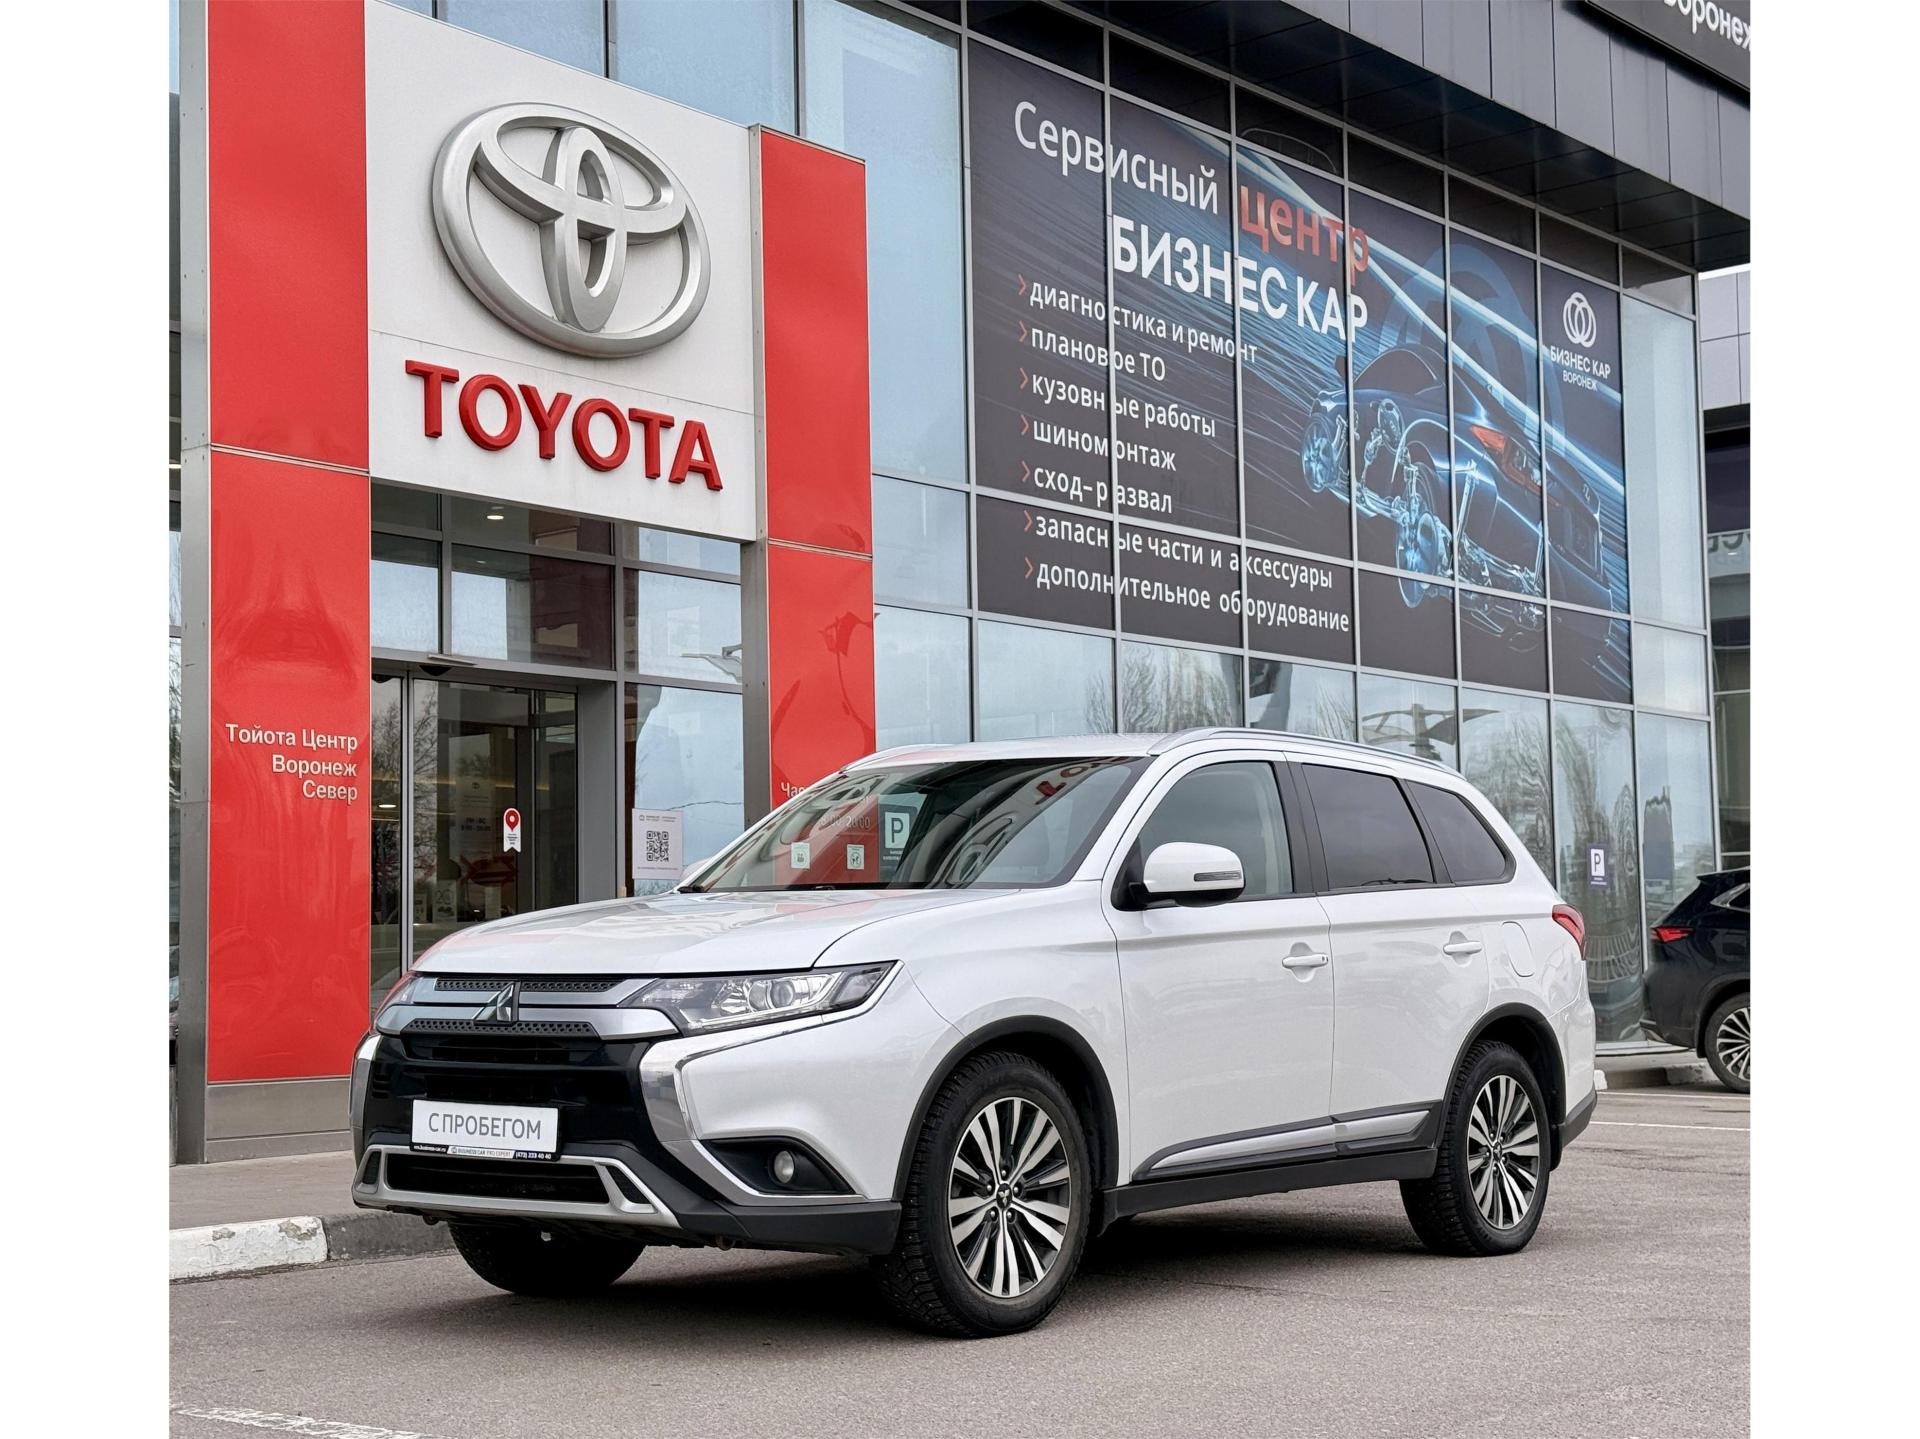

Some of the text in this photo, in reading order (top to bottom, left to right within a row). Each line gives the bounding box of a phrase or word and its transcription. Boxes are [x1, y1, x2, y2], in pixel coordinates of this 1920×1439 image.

[1664, 0, 1750, 52] ороне
[1014, 101, 1370, 286] Сервисный центр
[1113, 214, 1368, 344] БИЗНЕС КАР
[1029, 279, 1258, 364] диагностика и ремонт
[1031, 327, 1166, 382] плановое ТО
[1550, 345, 1611, 379] БИЗНЕС КАР
[1032, 371, 1216, 438] кузовные работы
[1562, 370, 1598, 392] ВОРОНЕЖ
[405, 359, 723, 492] TOYOTA
[1033, 419, 1177, 472] шиномонтаж
[1035, 515, 1333, 589] запасные части и аксессуары
[1037, 561, 1350, 632] дополнительное оборудование
[225, 722, 358, 754] Тойота Центр
[272, 754, 358, 779] Воронеж
[302, 780, 358, 805] Север
[891, 817, 904, 844] P
[1594, 852, 1602, 873] P
[428, 1112, 541, 1140] С ПРОБЕГОМ
